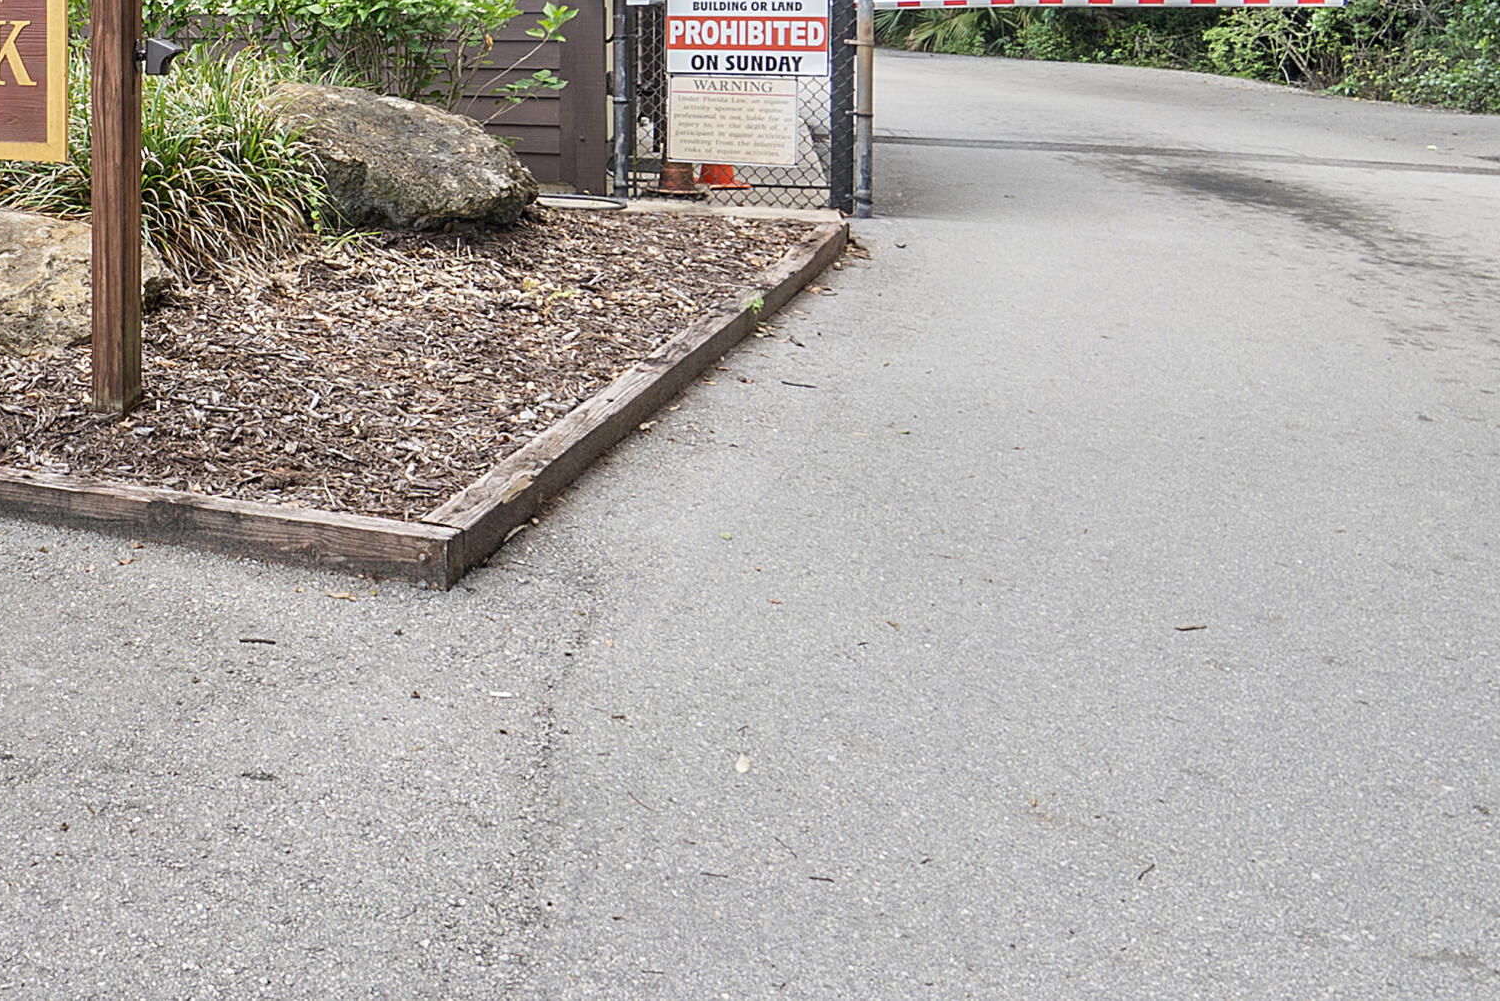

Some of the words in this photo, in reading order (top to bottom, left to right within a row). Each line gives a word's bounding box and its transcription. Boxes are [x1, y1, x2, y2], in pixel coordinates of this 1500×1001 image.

[692, 1, 748, 11] BUILDING
[750, 1, 768, 11] OR
[771, 1, 803, 11] LAND
[669, 19, 825, 47] PROHIBITED
[690, 54, 719, 71] ON
[725, 55, 803, 72] SUNDAY
[693, 79, 773, 93] WARNING
